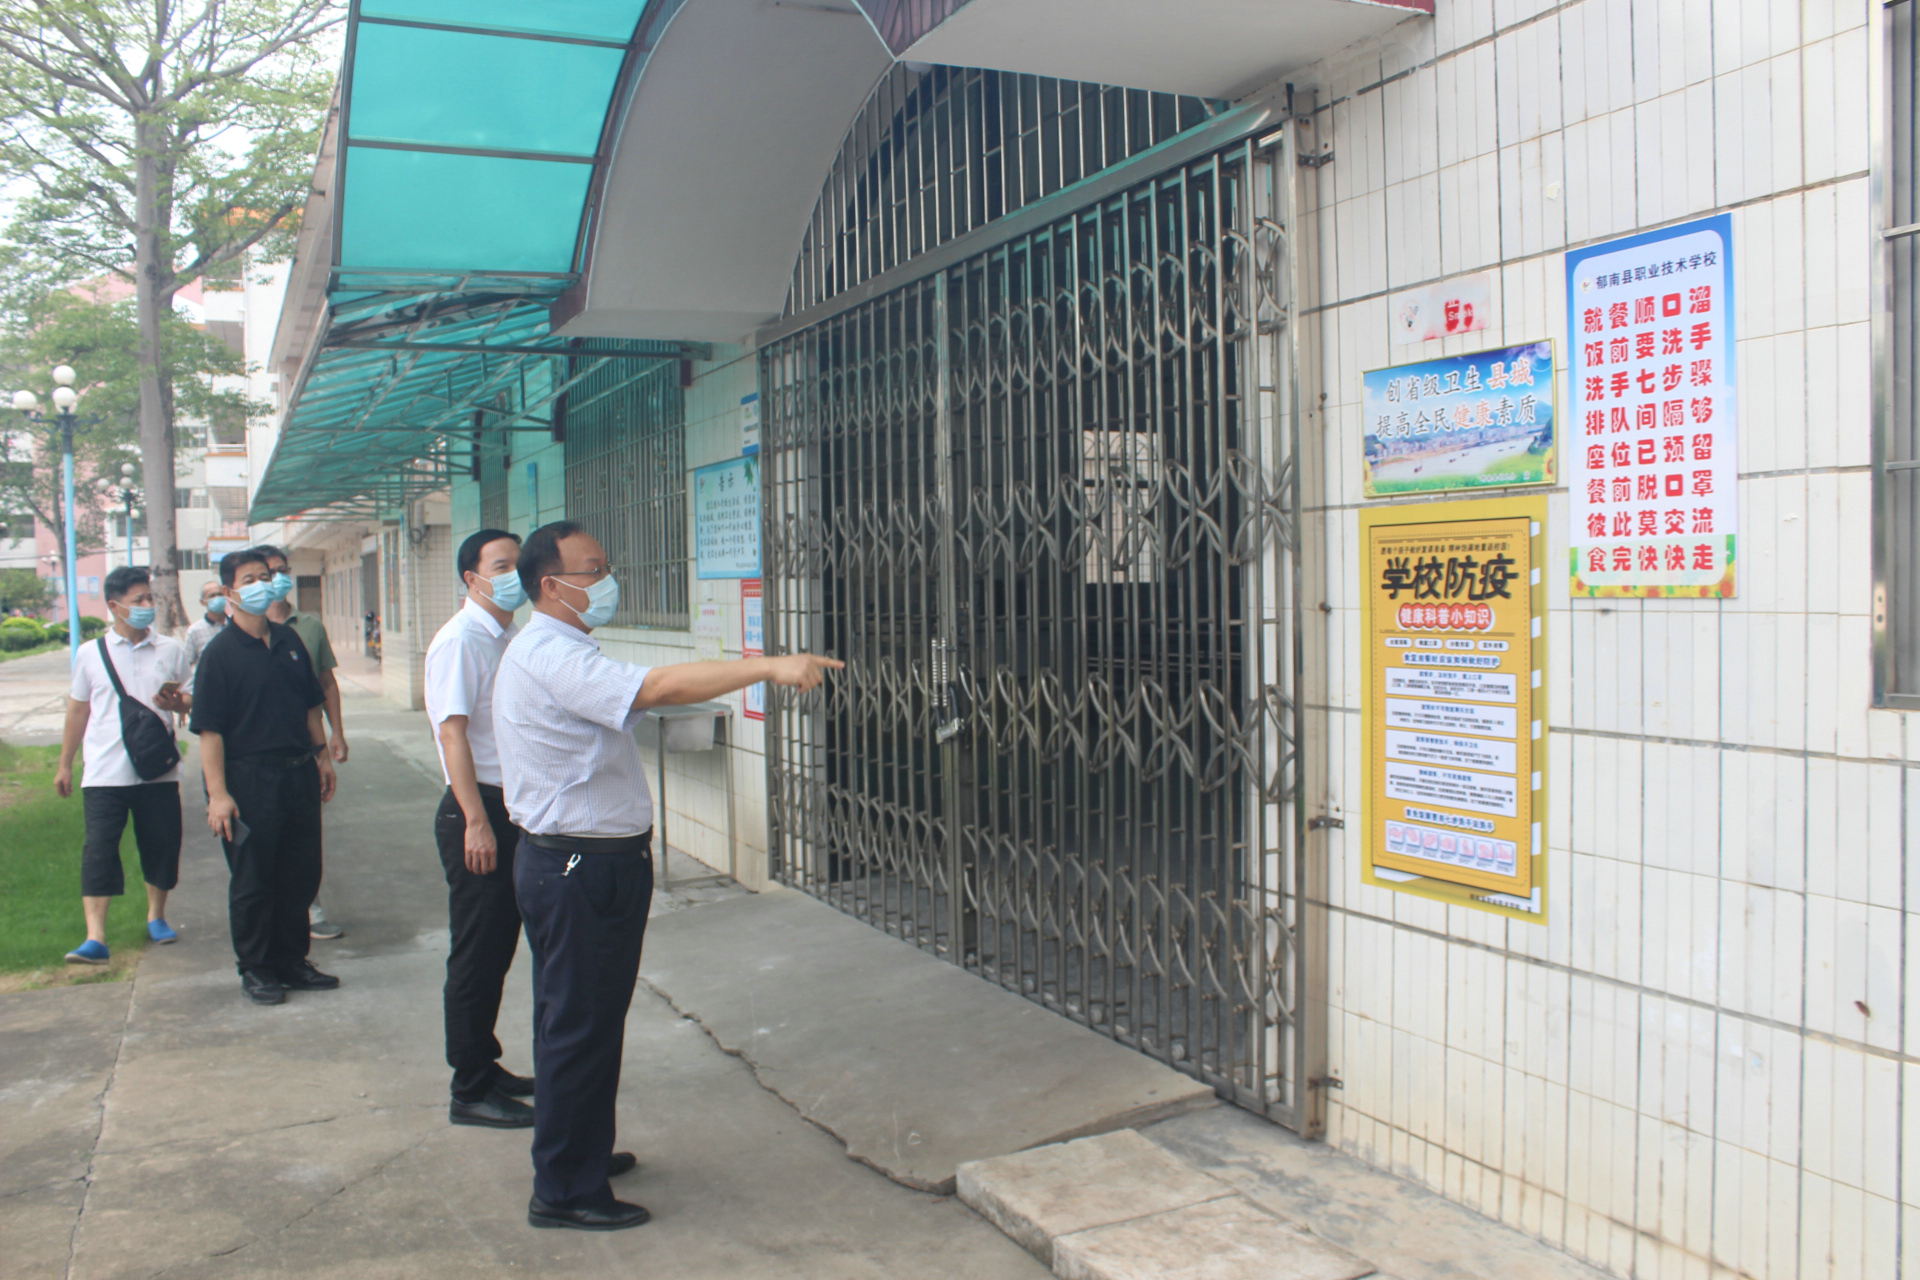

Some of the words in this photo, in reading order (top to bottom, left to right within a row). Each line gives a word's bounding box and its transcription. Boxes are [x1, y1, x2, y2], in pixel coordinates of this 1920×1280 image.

[1596, 250, 1717, 289] 郁南县职业技术学校
[1584, 285, 1712, 334] 就餐顺口溜
[1585, 321, 1712, 367] 饭前要洗手
[1385, 356, 1535, 403] 创省级卫生县城
[1586, 359, 1712, 401] 洗手七步骤
[1376, 394, 1537, 438] 提高全民健康素质
[1586, 396, 1713, 436] 排队间隔够
[1587, 433, 1713, 470] 座位已预留
[1587, 469, 1714, 504] 餐前脱口罩
[1587, 507, 1713, 538] 彼此莫交流
[1381, 553, 1519, 600] 学校防疫
[1587, 543, 1714, 572] 食完快快走
[1400, 607, 1490, 625] 健康科普小知识
